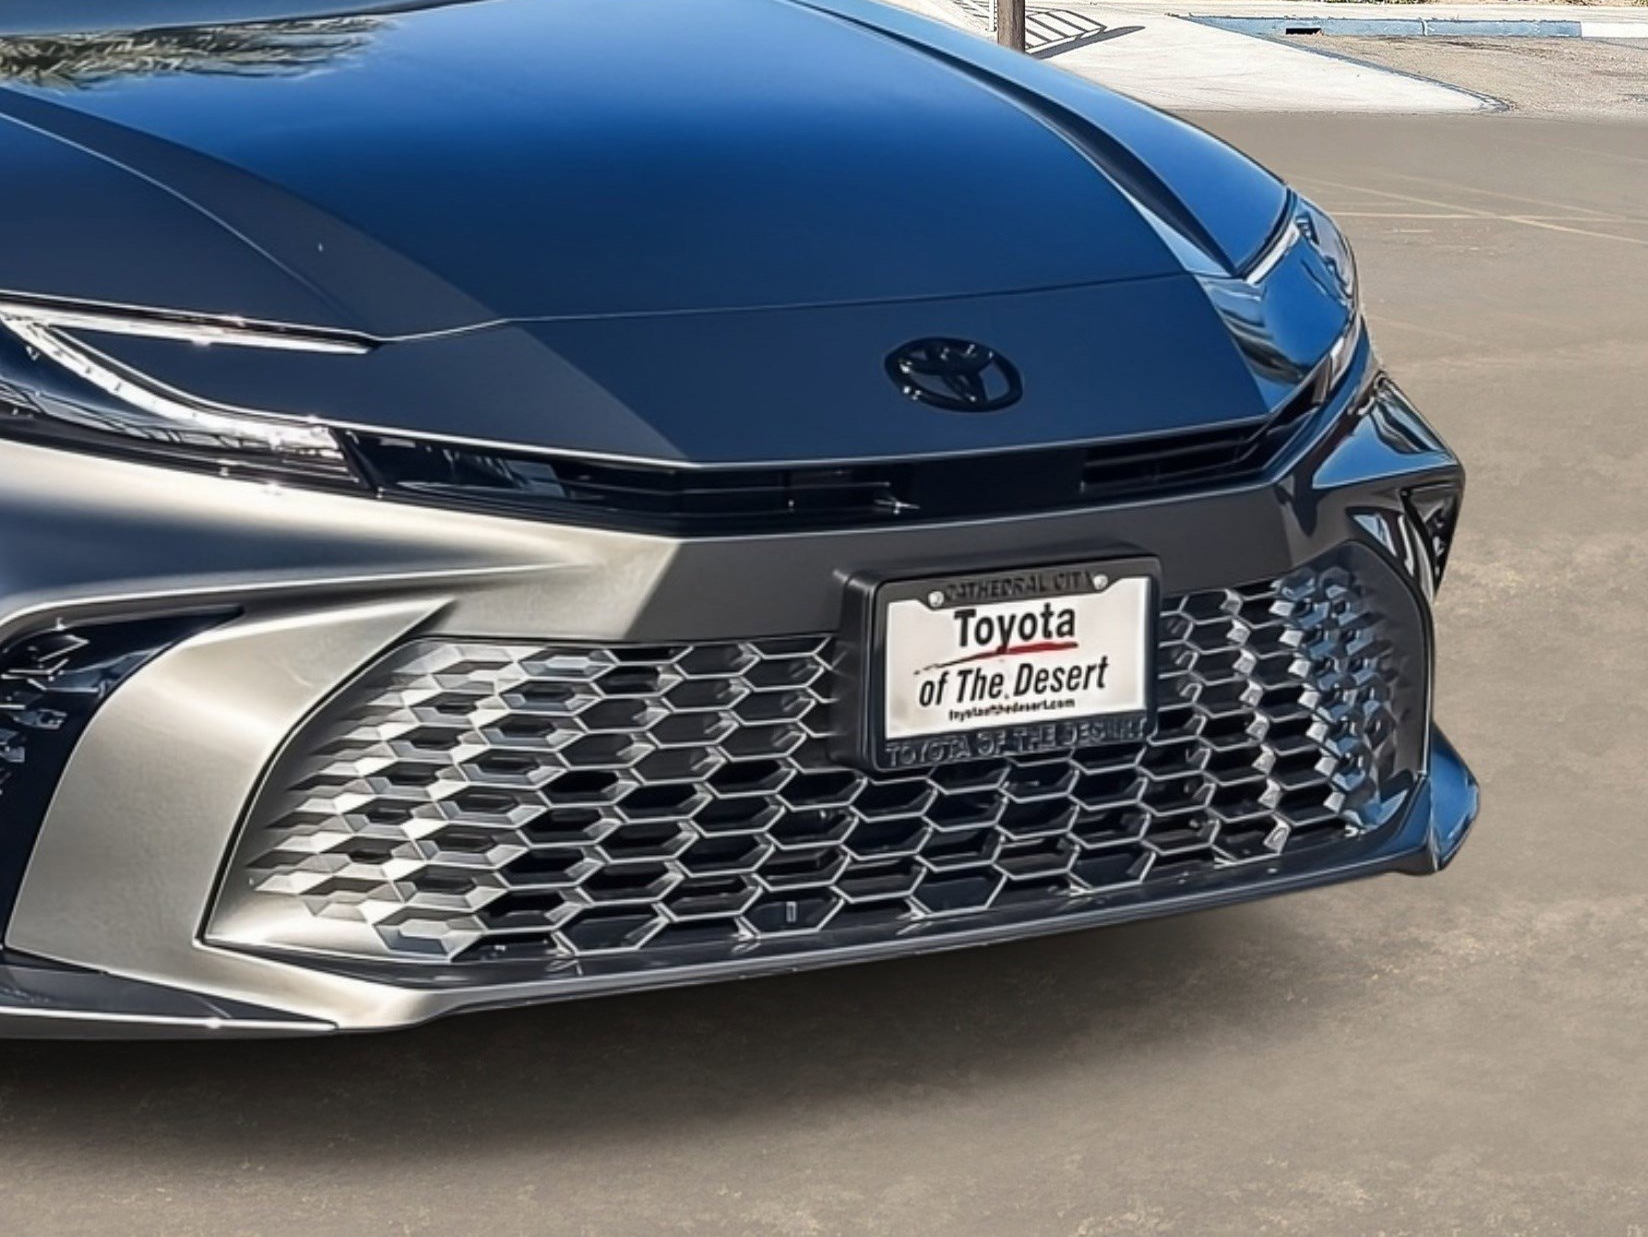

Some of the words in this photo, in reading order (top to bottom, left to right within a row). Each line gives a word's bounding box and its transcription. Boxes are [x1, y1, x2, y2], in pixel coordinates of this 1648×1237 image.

[954, 603, 1075, 652] Toyota
[919, 670, 949, 707] of
[956, 667, 1005, 704] The
[1013, 656, 1109, 697] Desert
[886, 735, 971, 766] TOYOTA
[977, 730, 1008, 756] OF
[1013, 725, 1055, 752] THE
